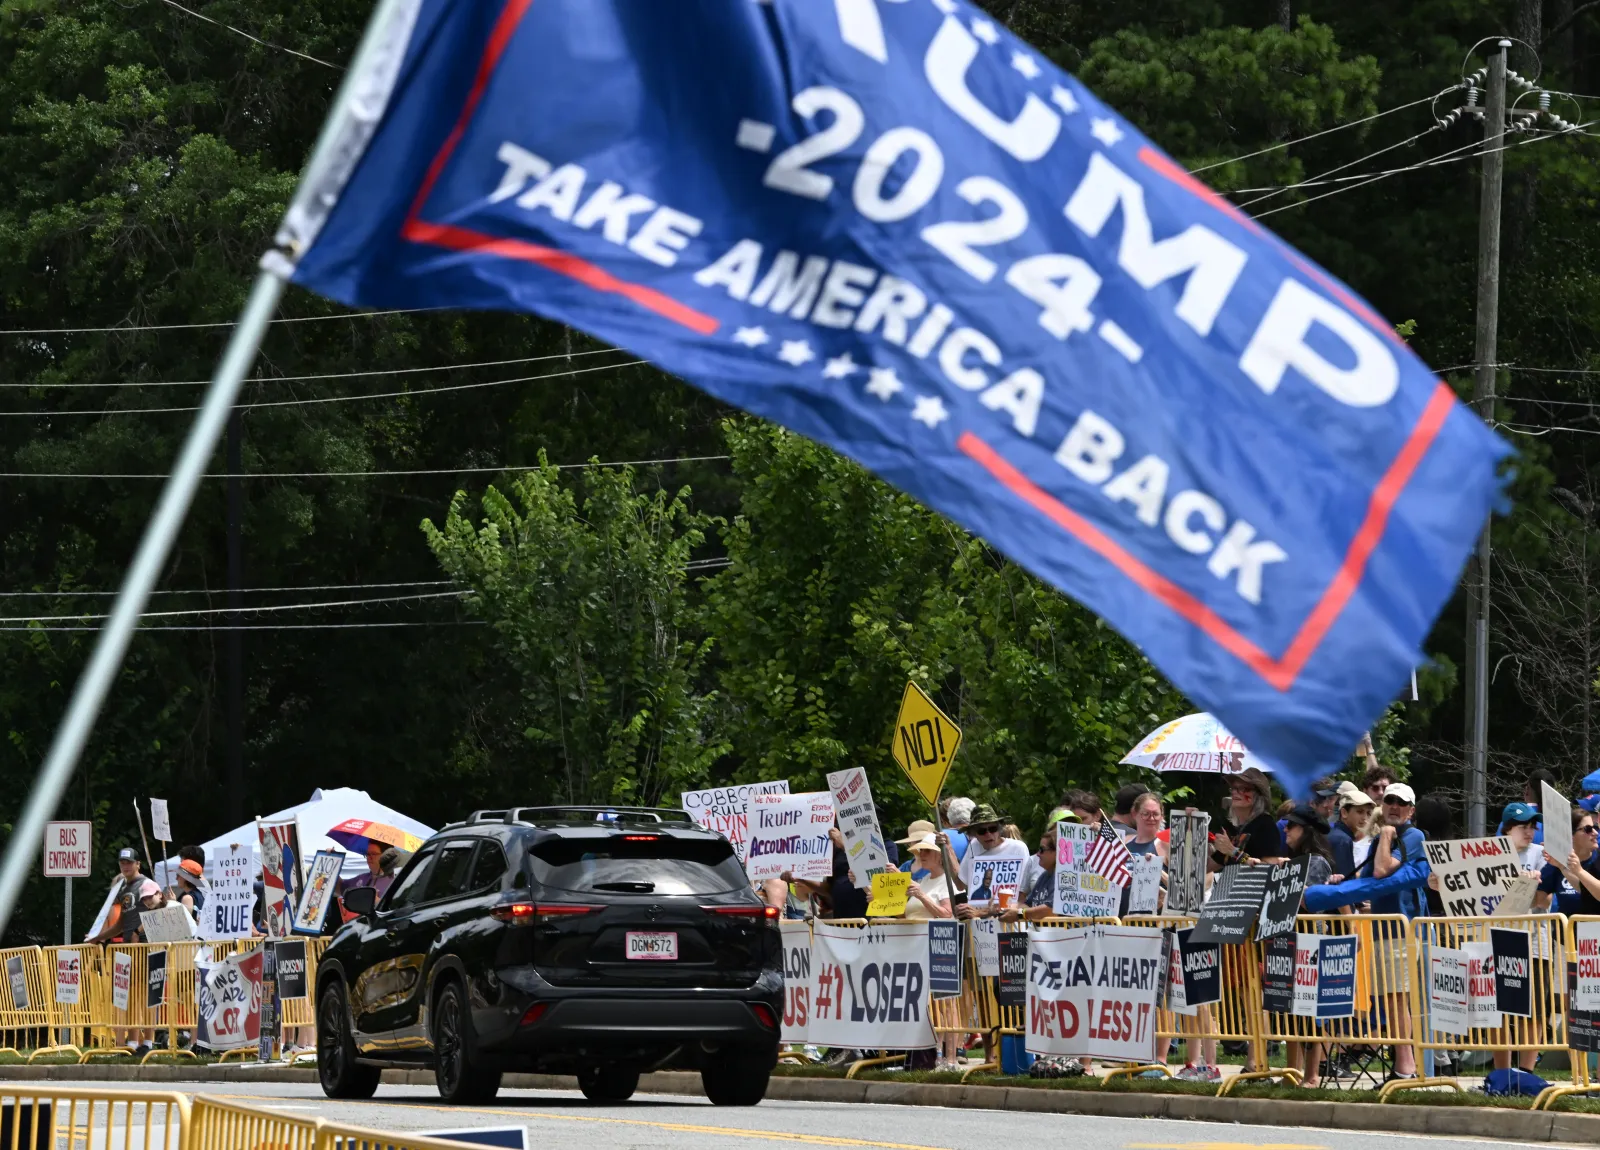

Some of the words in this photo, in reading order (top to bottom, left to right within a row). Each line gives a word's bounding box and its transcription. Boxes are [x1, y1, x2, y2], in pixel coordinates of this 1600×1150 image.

[835, 0, 1400, 408] UMP
[490, 141, 704, 268] TAKE
[693, 239, 1045, 436] AMERICA
[1054, 410, 1288, 604] BACK
[900, 717, 946, 771] NO!
[686, 788, 739, 808] COBB
[754, 796, 763, 804] WE
[712, 804, 748, 817] RULE
[756, 809, 802, 829] TRUMP
[60, 828, 77, 846] BUS
[1060, 824, 1076, 838] WHY
[1080, 827, 1087, 840] IS
[750, 834, 830, 858] ACCOUNTABILITY
[1426, 842, 1453, 865] HEY
[49, 850, 87, 869] ENTRANCE
[220, 858, 247, 868] VOTED
[316, 856, 339, 877] NO!
[975, 861, 1022, 873] PROTECT
[225, 870, 241, 878] RED
[996, 875, 1017, 885] OUR
[1060, 873, 1077, 885] READ
[1272, 862, 1288, 882] Grab
[1444, 870, 1471, 892] GET
[1477, 863, 1519, 887] OUTTA
[215, 880, 230, 888] BUT
[880, 875, 906, 889] Silence
[1278, 881, 1289, 903] by
[1290, 877, 1303, 895] the
[216, 891, 250, 901] TURING
[888, 890, 894, 898] is
[1060, 890, 1087, 906] CAMPAIGN
[1088, 896, 1105, 906] EVENT
[1108, 898, 1116, 908] AT
[871, 900, 905, 913] Compliance
[1063, 903, 1080, 914] OUR
[1448, 897, 1478, 917] MY
[216, 904, 250, 933] BLUE
[976, 920, 995, 934] VOTE
[934, 926, 954, 936] DUMONT
[931, 940, 957, 956] WALKER
[1010, 938, 1028, 949] CHRIS
[1326, 944, 1351, 957] DUMONT
[1579, 939, 1598, 956] MIKE
[278, 958, 305, 974] JACKSON
[783, 947, 810, 980] LON
[1003, 955, 1027, 974] HARD
[1185, 948, 1218, 972] JACKSON
[1266, 955, 1293, 976] HARDEN
[1321, 958, 1354, 977] WALKER
[1441, 956, 1458, 970] CHRIS
[1469, 959, 1481, 975] IKE
[1497, 955, 1528, 978] JACKSON
[1579, 957, 1600, 979] COLL
[58, 972, 79, 985] COLLINS
[1097, 956, 1109, 987] A
[1112, 956, 1157, 990] HEART
[1193, 970, 1212, 980] GOVERNOR
[1296, 967, 1318, 987] OLLIN
[816, 962, 844, 1021] #1
[845, 962, 924, 1023] LOSER
[1322, 986, 1334, 996] STATE
[1334, 986, 1346, 996] HOUSE
[1434, 972, 1465, 995] HARDEN
[1478, 1004, 1496, 1012] SENATE
[1136, 1002, 1151, 1043] IT
